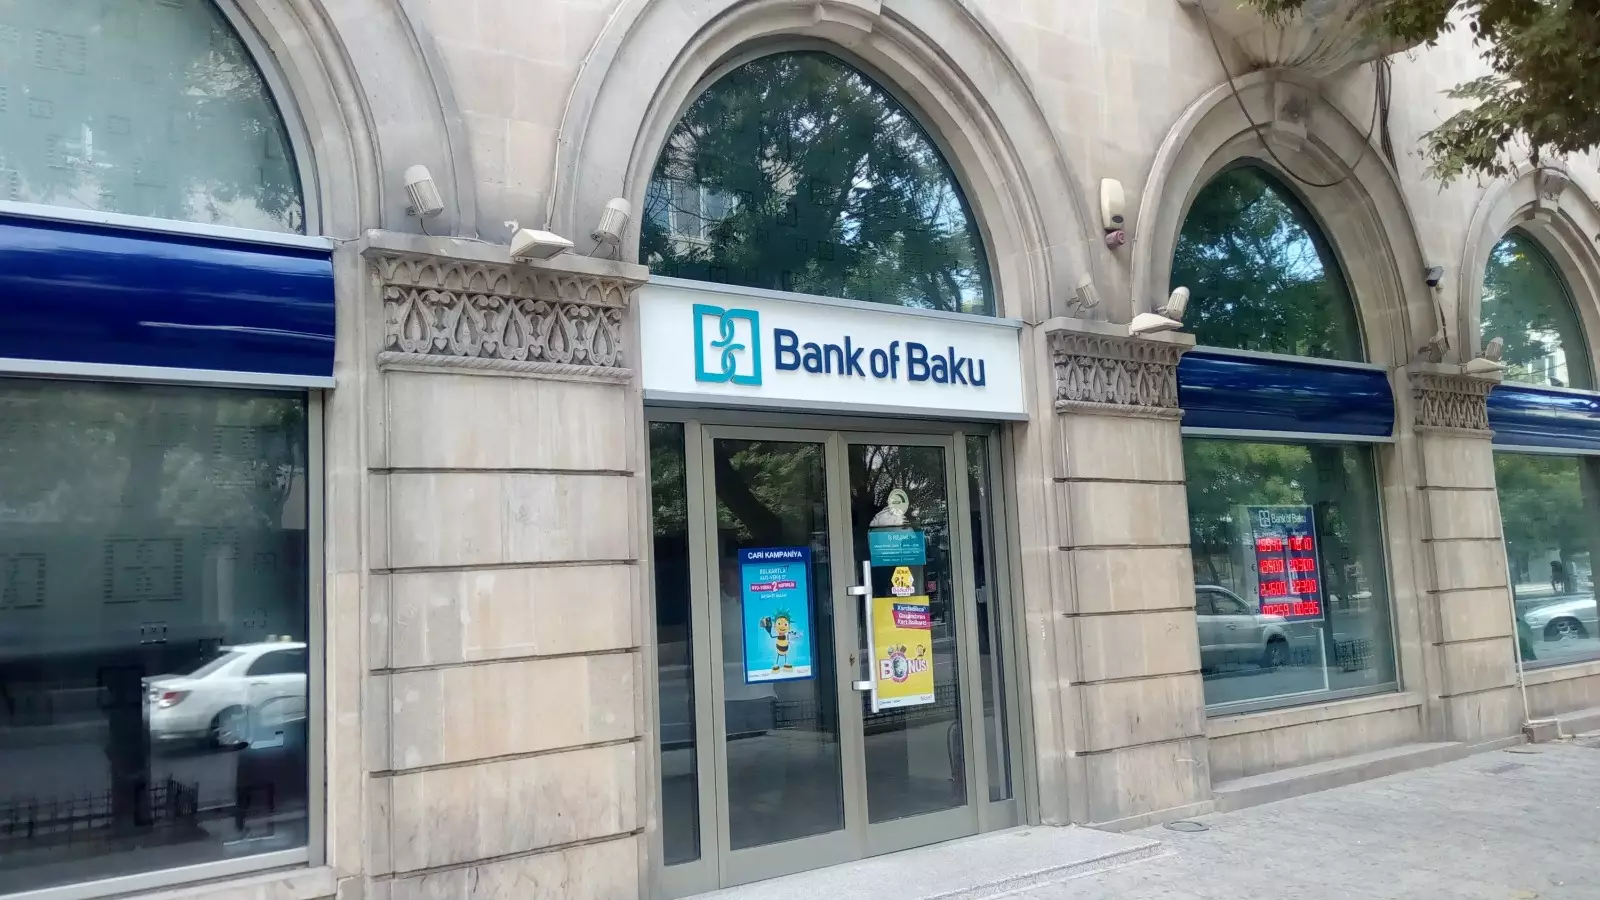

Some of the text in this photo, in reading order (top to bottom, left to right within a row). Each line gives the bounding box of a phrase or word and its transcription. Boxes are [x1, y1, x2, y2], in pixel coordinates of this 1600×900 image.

[773, 327, 986, 387] Bank of Baku
[1271, 513, 1307, 524] Bank of Baku
[765, 550, 803, 559] KAMPANİYA
[771, 581, 778, 592] 2
